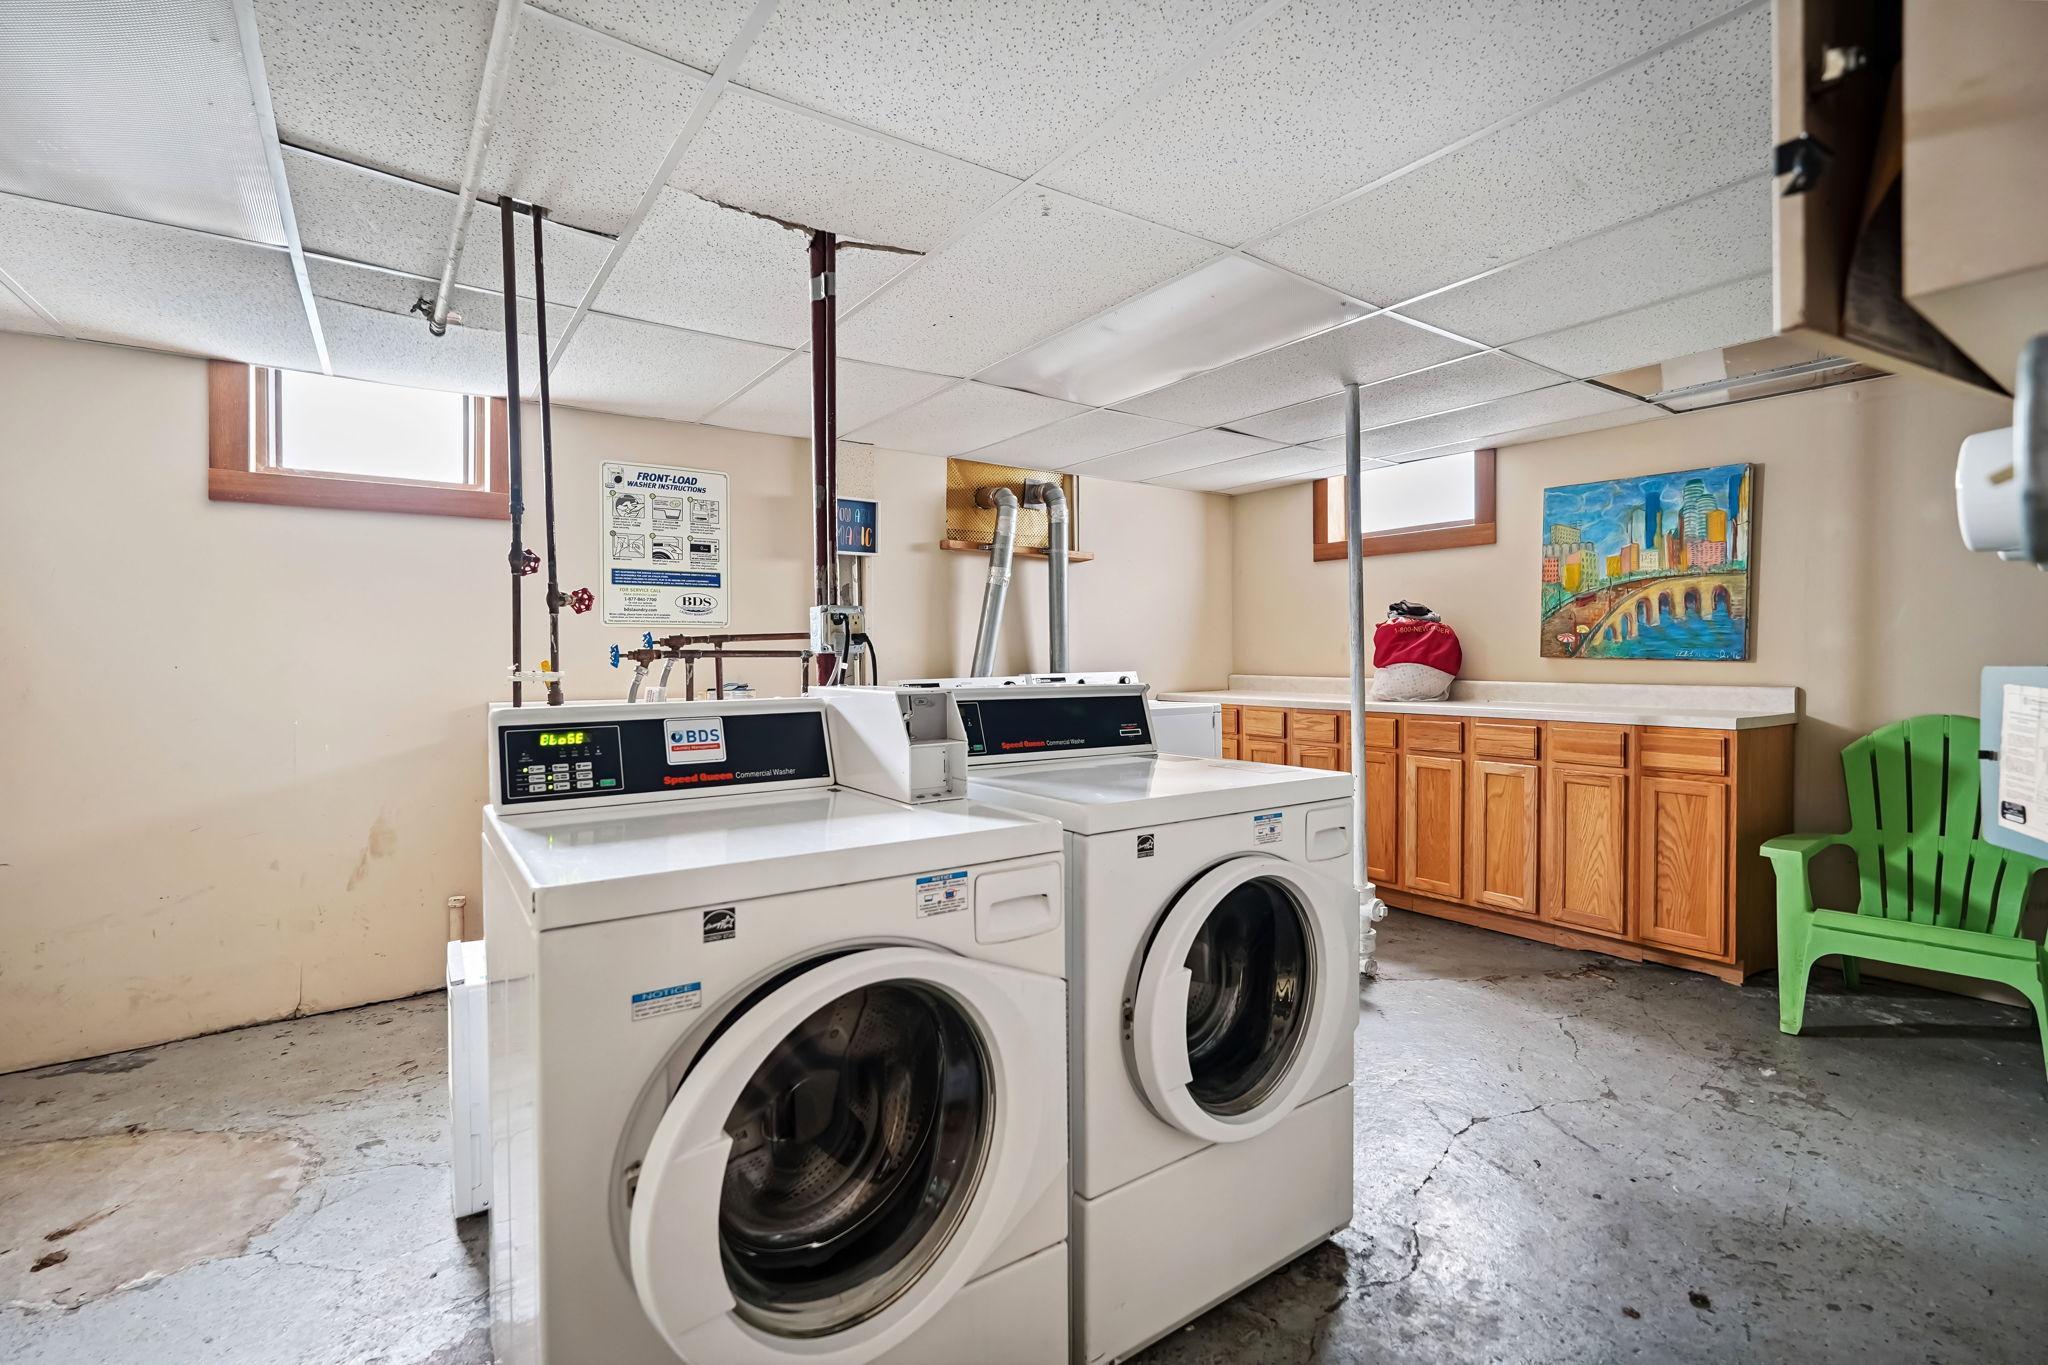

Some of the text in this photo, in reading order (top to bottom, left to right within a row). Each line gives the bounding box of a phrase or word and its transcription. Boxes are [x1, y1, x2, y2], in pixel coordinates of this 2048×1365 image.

[637, 472, 698, 486] FRONT-LOAD
[627, 480, 706, 494] WASHER INSTRUCTIONS
[837, 506, 852, 523] OU
[682, 596, 712, 607] BDS
[686, 728, 720, 744] BDS
[1001, 741, 1024, 750] Speed
[663, 767, 796, 785] Speed Queen Commercial Washer
[641, 985, 693, 1001] NOTICE
